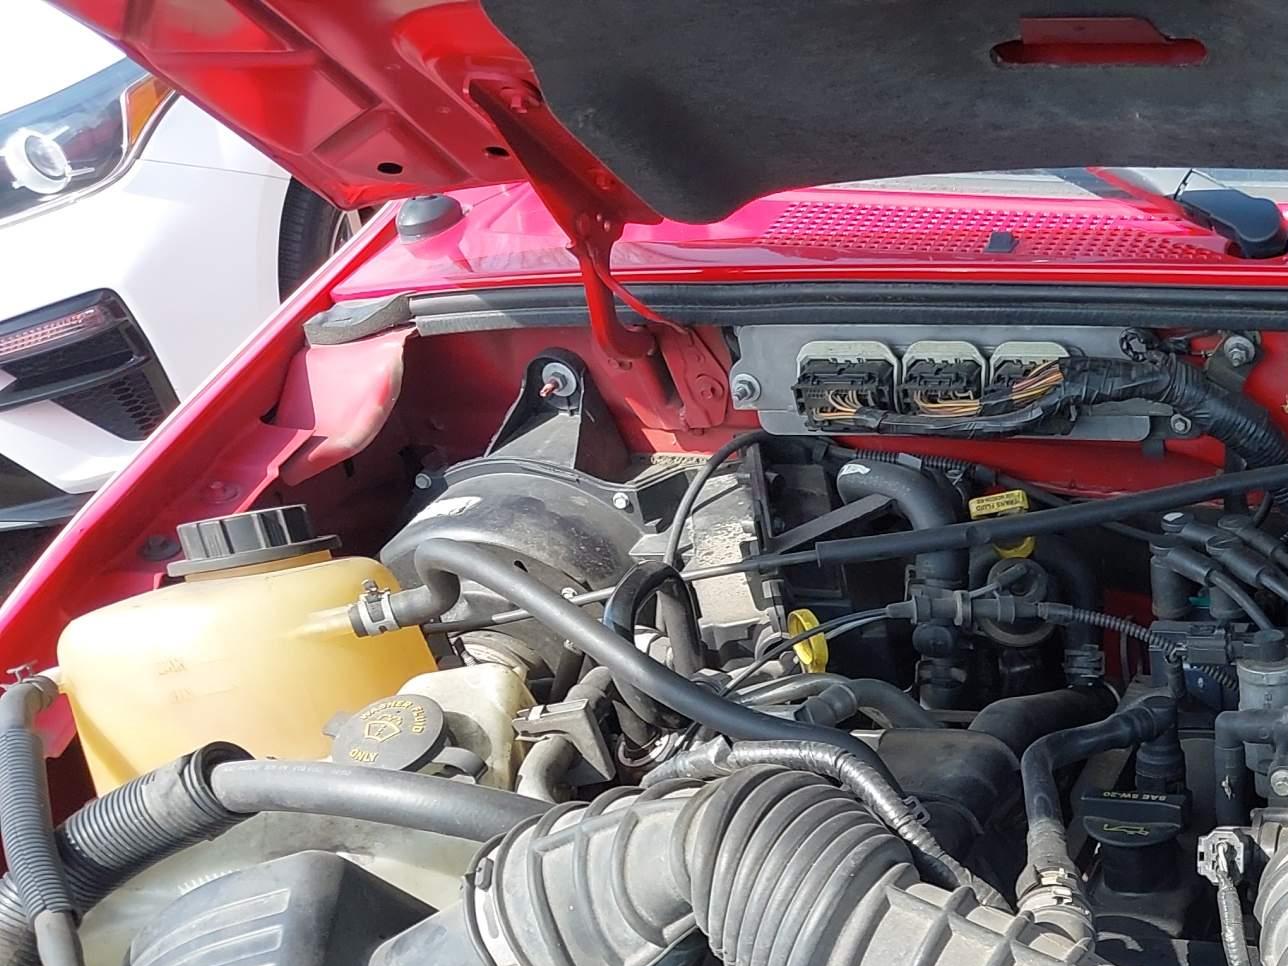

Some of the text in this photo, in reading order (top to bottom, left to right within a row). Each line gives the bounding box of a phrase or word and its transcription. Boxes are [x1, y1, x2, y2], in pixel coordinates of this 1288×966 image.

[360, 700, 427, 734] WASHER FLUID
[349, 748, 379, 763] ONLY
